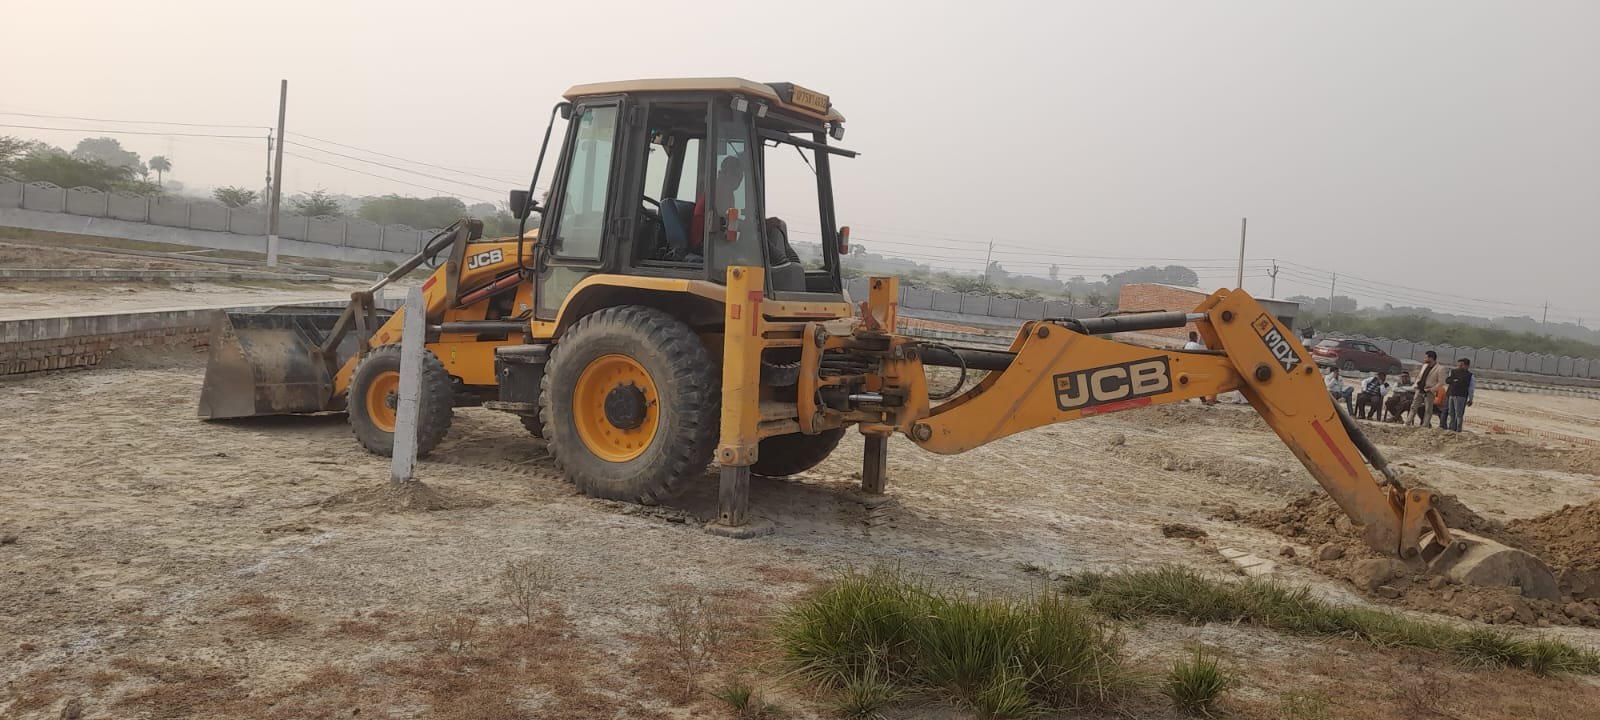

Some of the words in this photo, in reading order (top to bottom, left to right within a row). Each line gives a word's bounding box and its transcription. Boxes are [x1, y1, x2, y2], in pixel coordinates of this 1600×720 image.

[469, 249, 503, 269] JCB
[1265, 329, 1299, 371] 3DX
[1060, 360, 1169, 408] JCB
